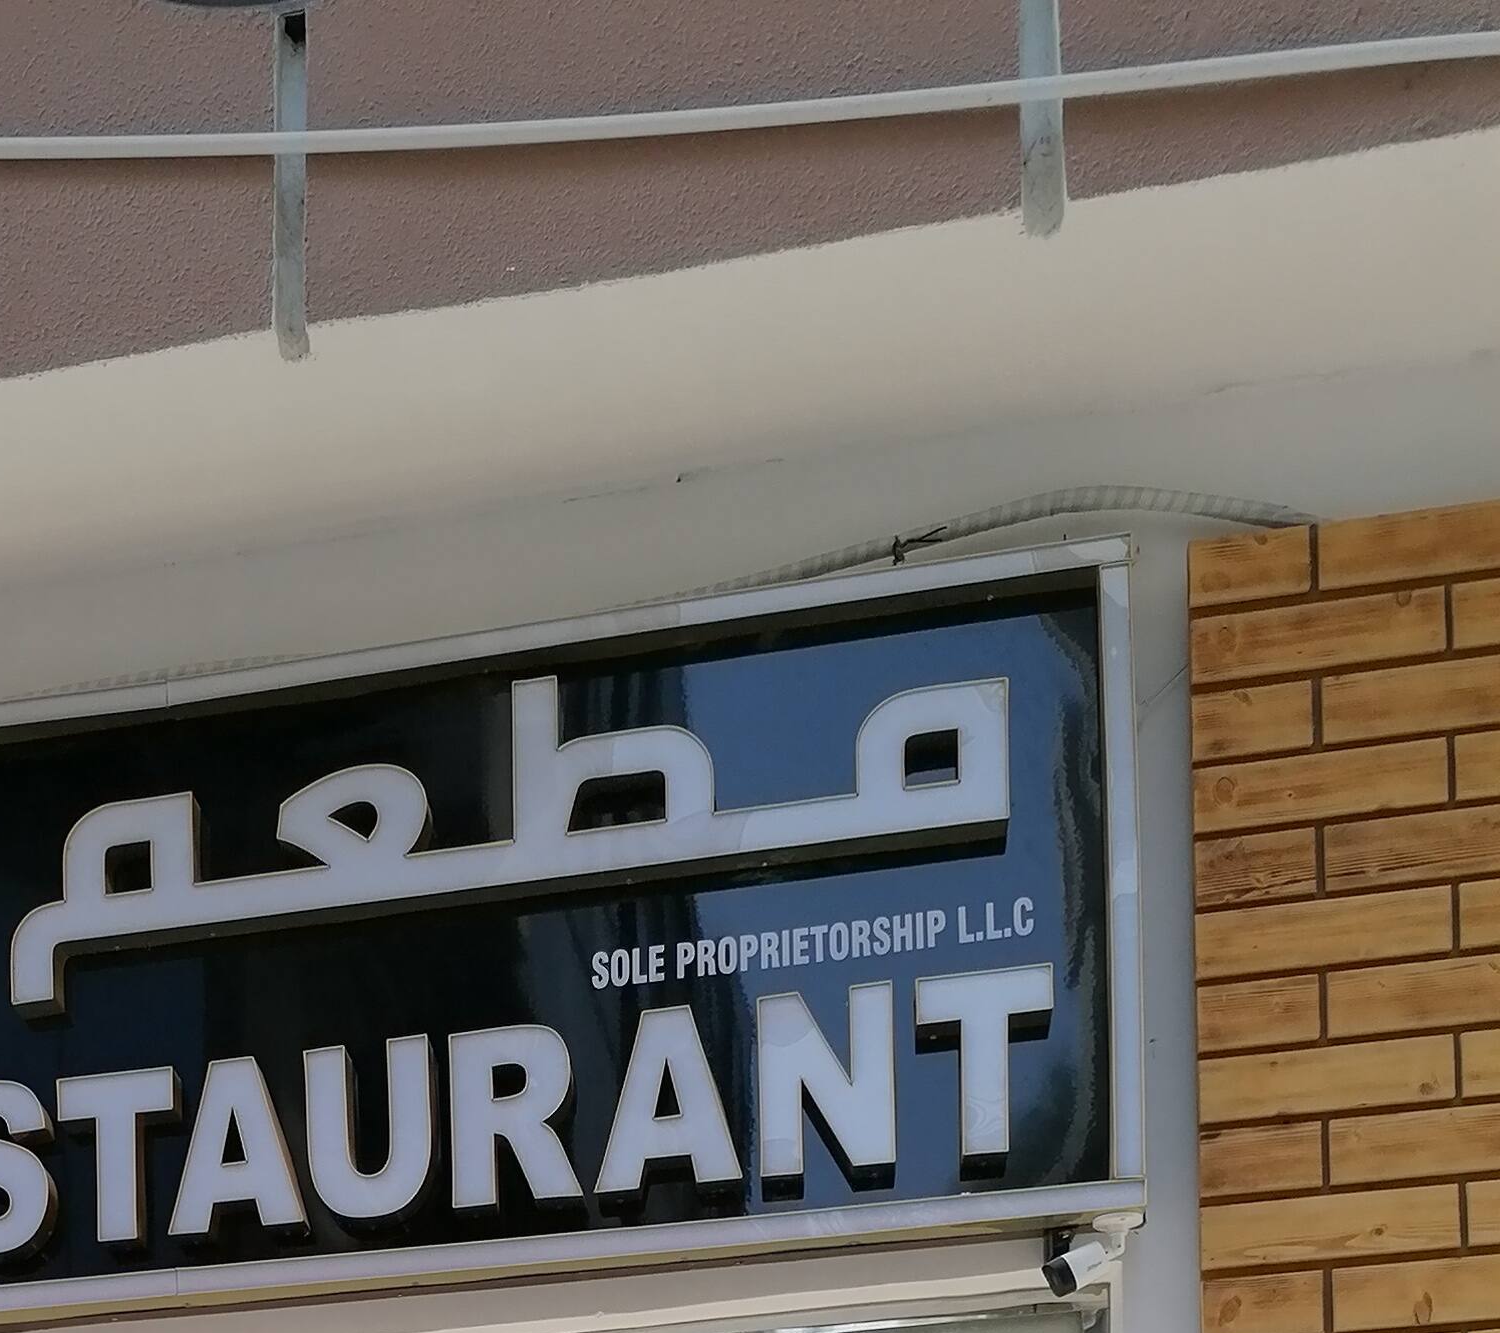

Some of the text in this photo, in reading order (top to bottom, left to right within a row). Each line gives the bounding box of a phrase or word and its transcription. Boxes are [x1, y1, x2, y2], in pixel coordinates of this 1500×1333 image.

[9, 674, 1010, 1006] مطعم
[591, 896, 1036, 990] SOLE PROPRIETORSHIP L.L.C
